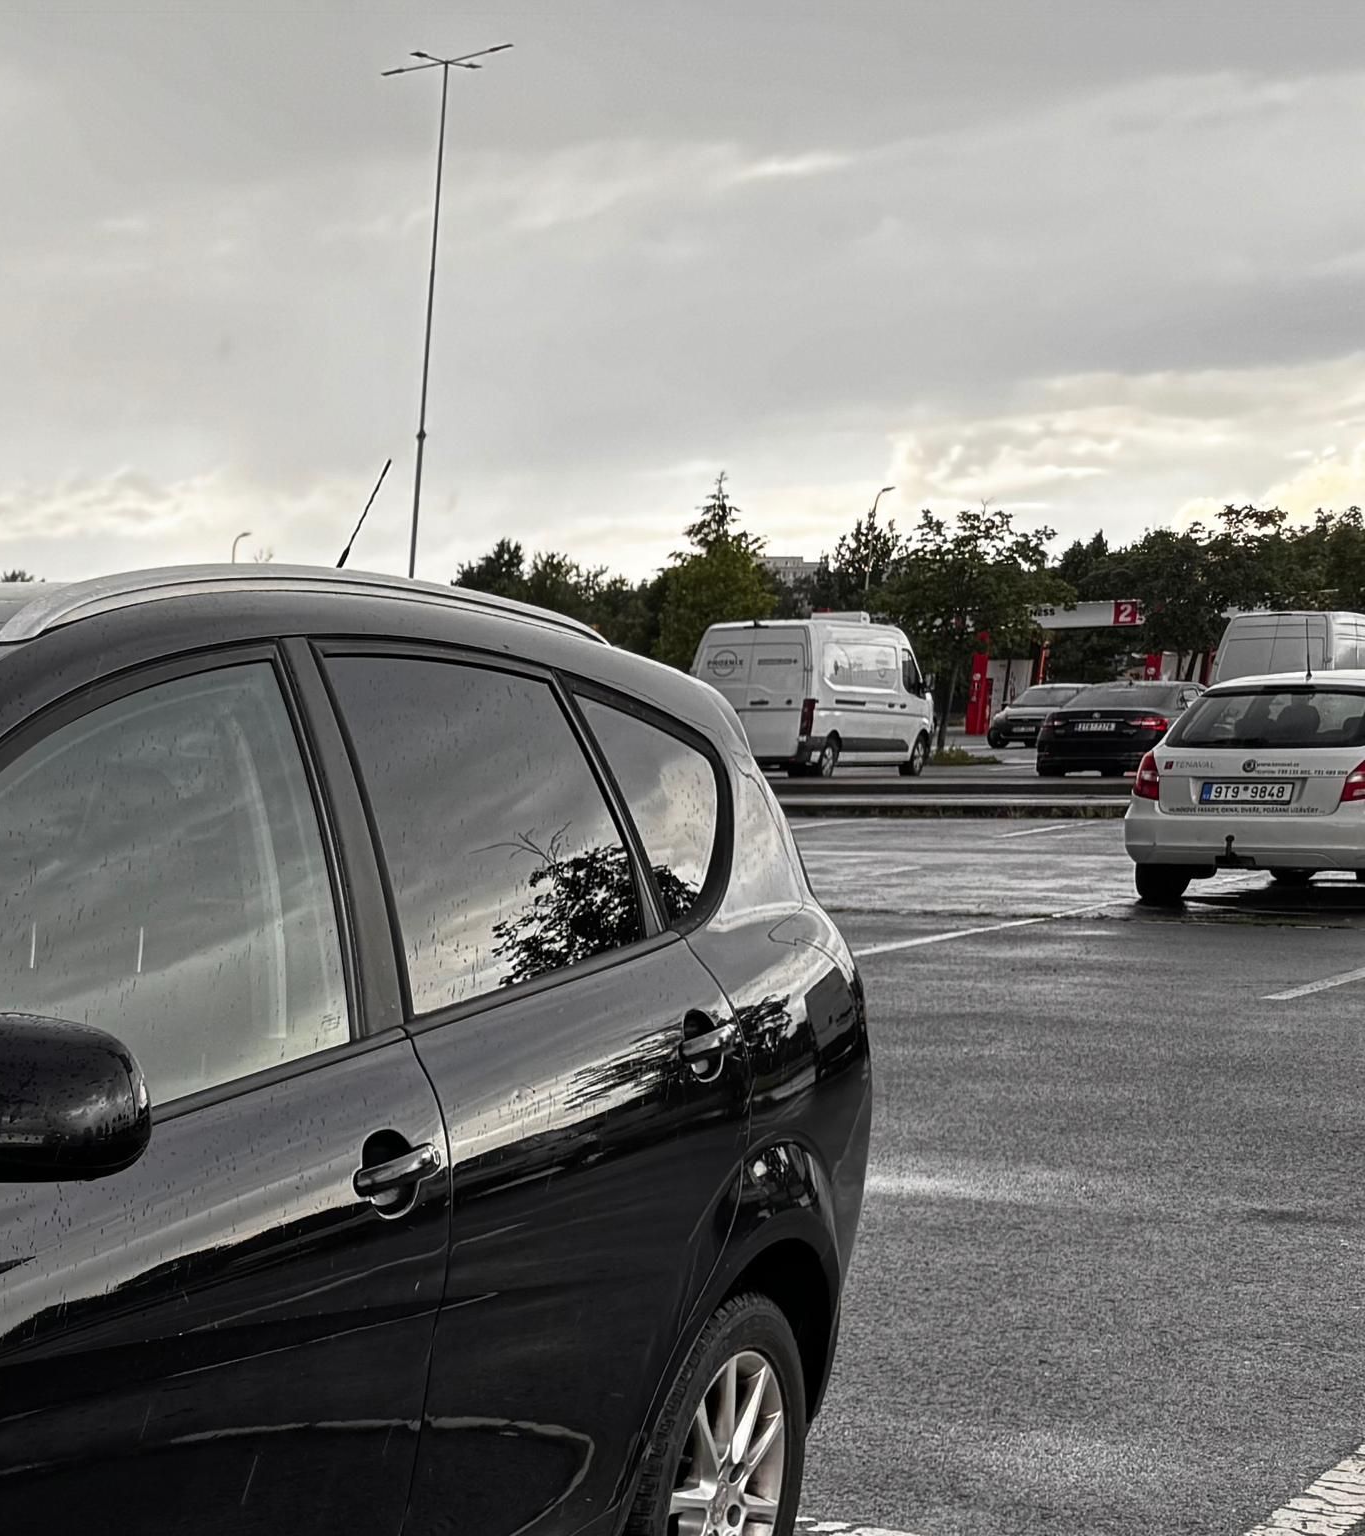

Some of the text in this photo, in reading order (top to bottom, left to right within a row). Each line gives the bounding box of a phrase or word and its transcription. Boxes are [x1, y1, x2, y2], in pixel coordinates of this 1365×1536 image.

[1119, 604, 1133, 622] 2
[1213, 785, 1239, 799] 9T9
[1250, 786, 1285, 799] 9848
